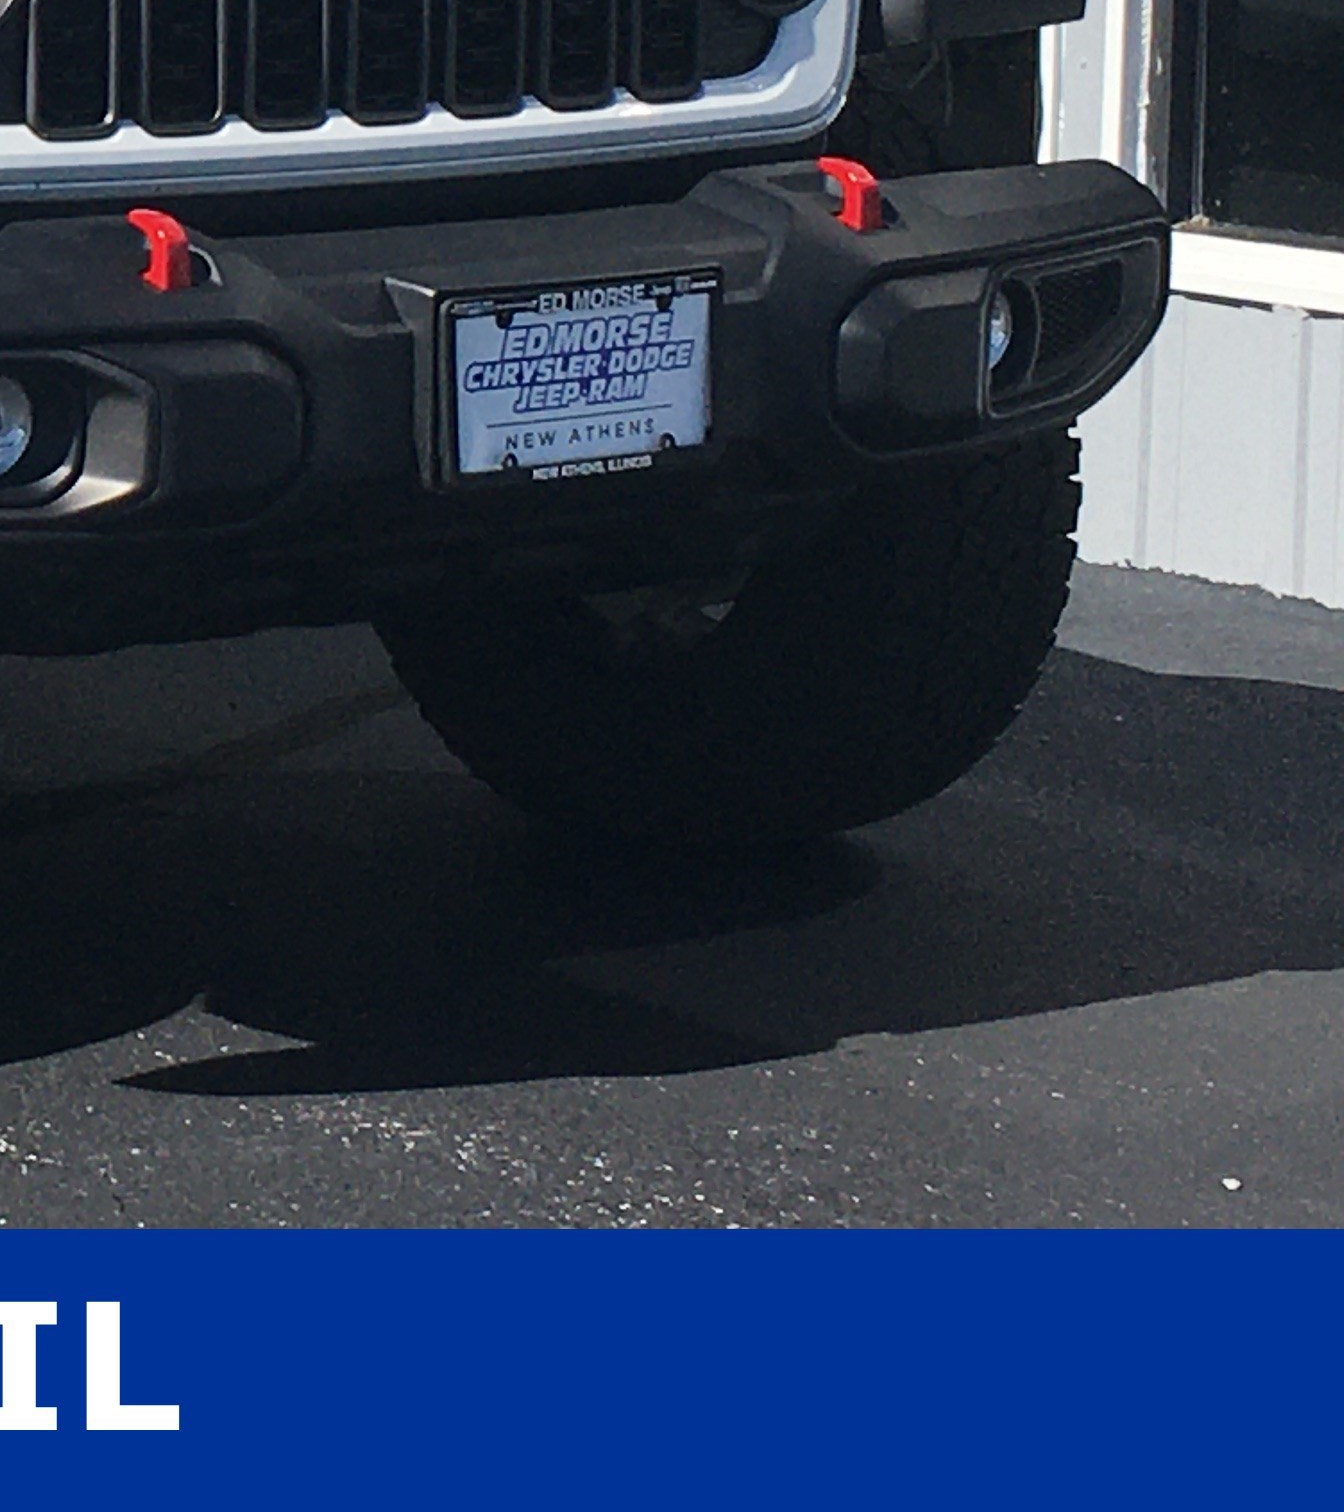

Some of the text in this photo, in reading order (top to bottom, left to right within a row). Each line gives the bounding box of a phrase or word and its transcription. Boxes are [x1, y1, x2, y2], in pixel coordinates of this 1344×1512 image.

[538, 292, 567, 314] ED
[572, 284, 645, 311] MORSE
[553, 311, 672, 356] MORSE
[505, 417, 654, 449] NEW ATHENS
